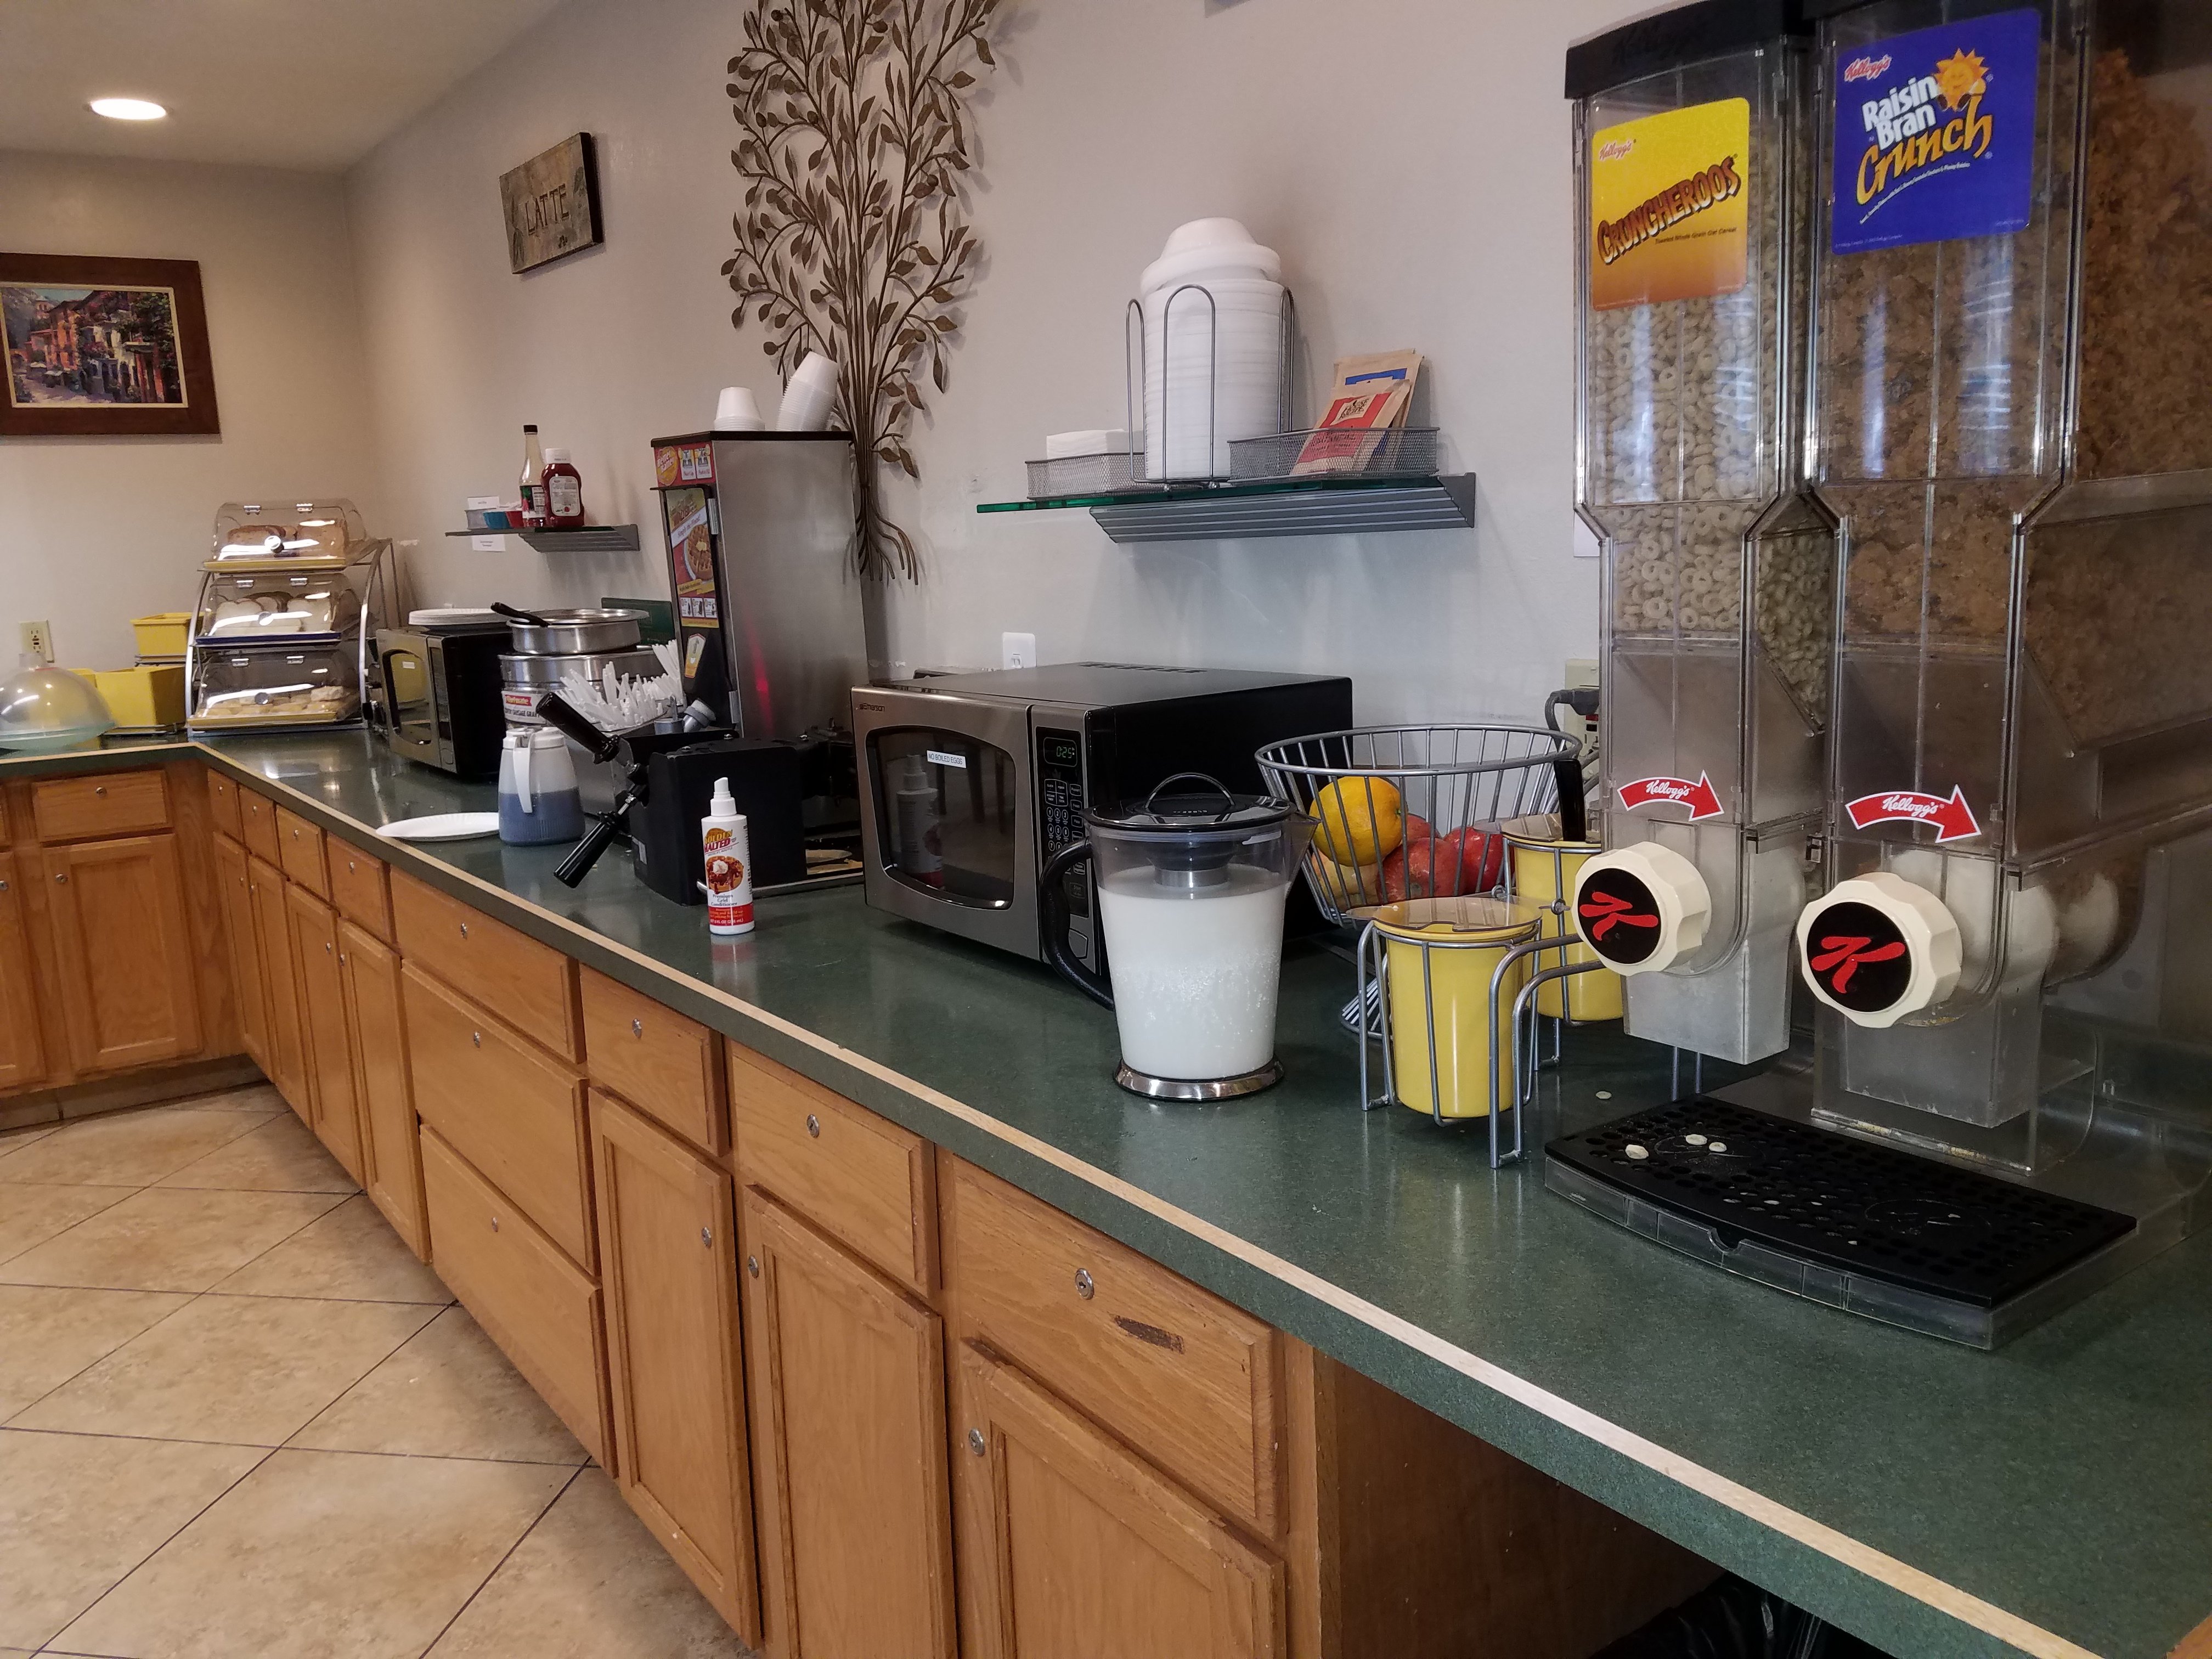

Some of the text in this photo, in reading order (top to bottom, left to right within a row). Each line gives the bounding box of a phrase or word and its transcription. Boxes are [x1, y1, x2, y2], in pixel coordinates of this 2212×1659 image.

[1844, 54, 1892, 82] Kellogg's
[1862, 75, 1940, 132] Raisin
[1876, 104, 1937, 150] Bran
[1599, 139, 1632, 161] Kellogg's
[1857, 93, 1993, 205] Crunch
[525, 183, 569, 236] LATTE
[1598, 155, 1742, 266] CRUNCHEROOS
[935, 754, 950, 763] BOILED
[950, 757, 963, 765] EGGS
[1646, 780, 1690, 799] Kellogg's
[1882, 794, 1939, 818] Kellogg's
[704, 838, 731, 853] MALTED
